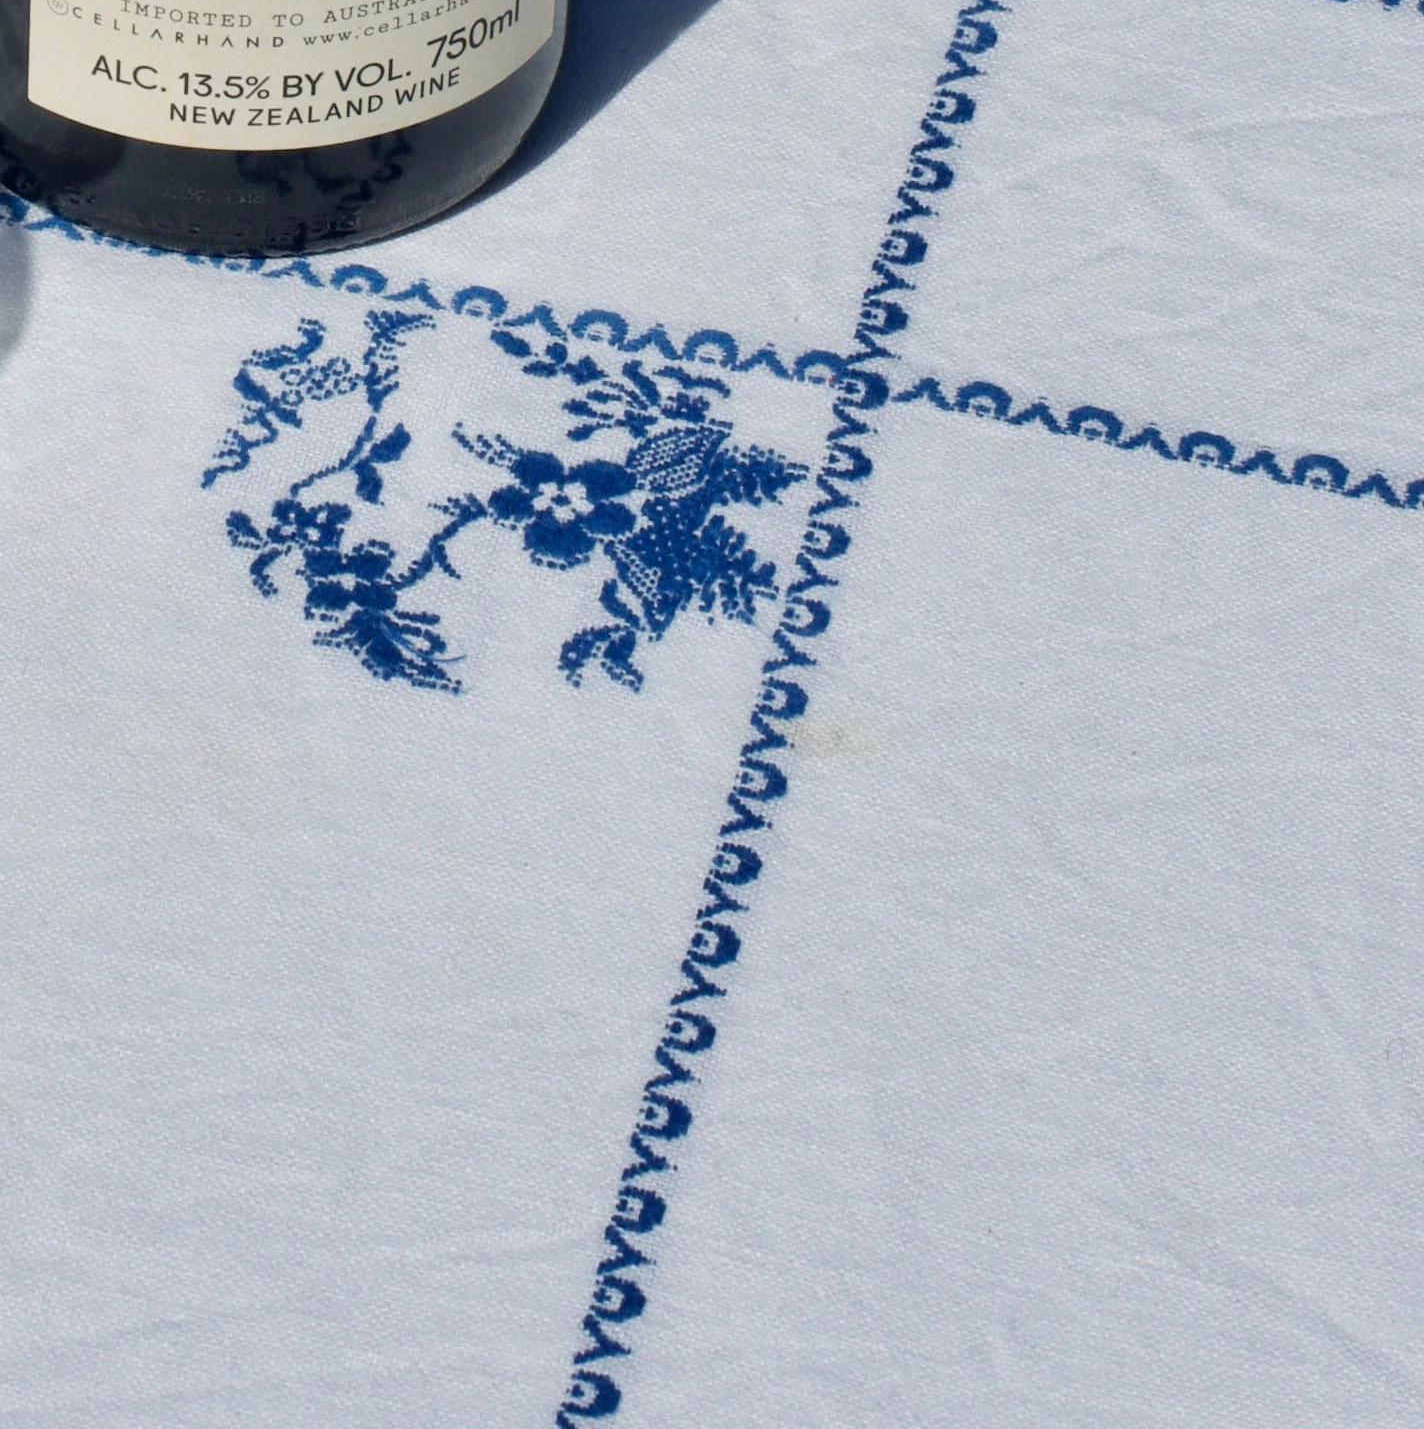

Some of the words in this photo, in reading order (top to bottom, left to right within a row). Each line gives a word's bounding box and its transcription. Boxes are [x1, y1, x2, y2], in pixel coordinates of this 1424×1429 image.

[120, 0, 252, 28] IMPORTED
[273, 13, 304, 27] TO
[91, 54, 167, 92] ALC.
[178, 72, 271, 100] 13.5%
[282, 71, 324, 99] BY
[335, 58, 412, 92] VOL.
[170, 103, 236, 126] NEW
[247, 94, 383, 126] ZEALAND
[395, 67, 461, 105] WINE
